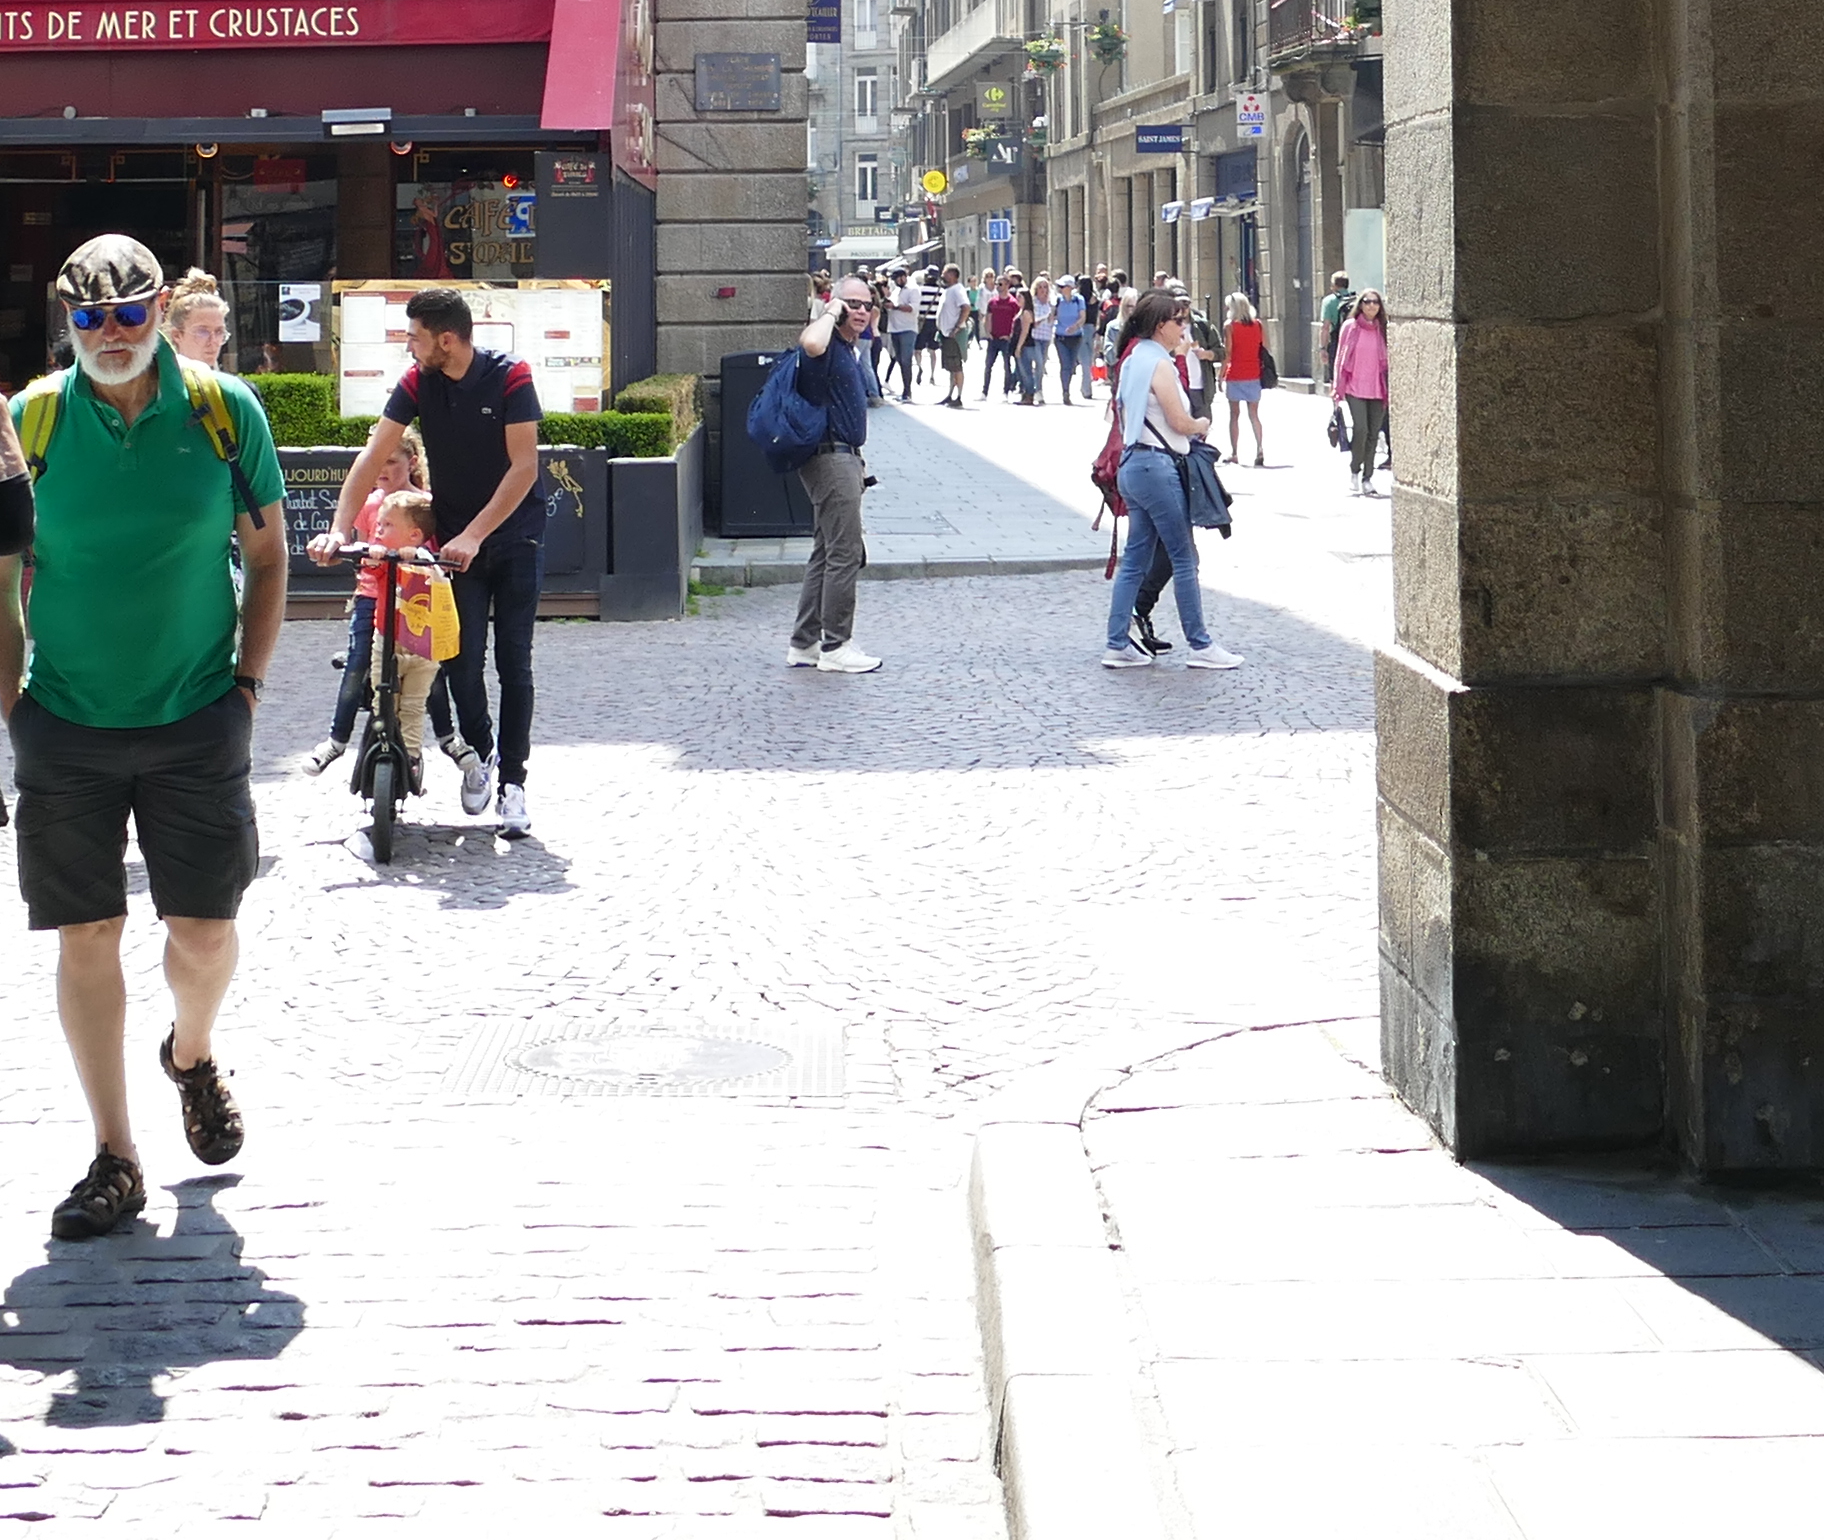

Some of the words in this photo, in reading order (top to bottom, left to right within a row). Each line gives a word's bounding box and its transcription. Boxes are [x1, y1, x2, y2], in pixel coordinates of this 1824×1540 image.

[47, 11, 83, 40] DE
[95, 10, 157, 40] MER
[168, 9, 199, 39] ET
[209, 6, 361, 38] CRUSTACES
[1239, 112, 1265, 122] CMB
